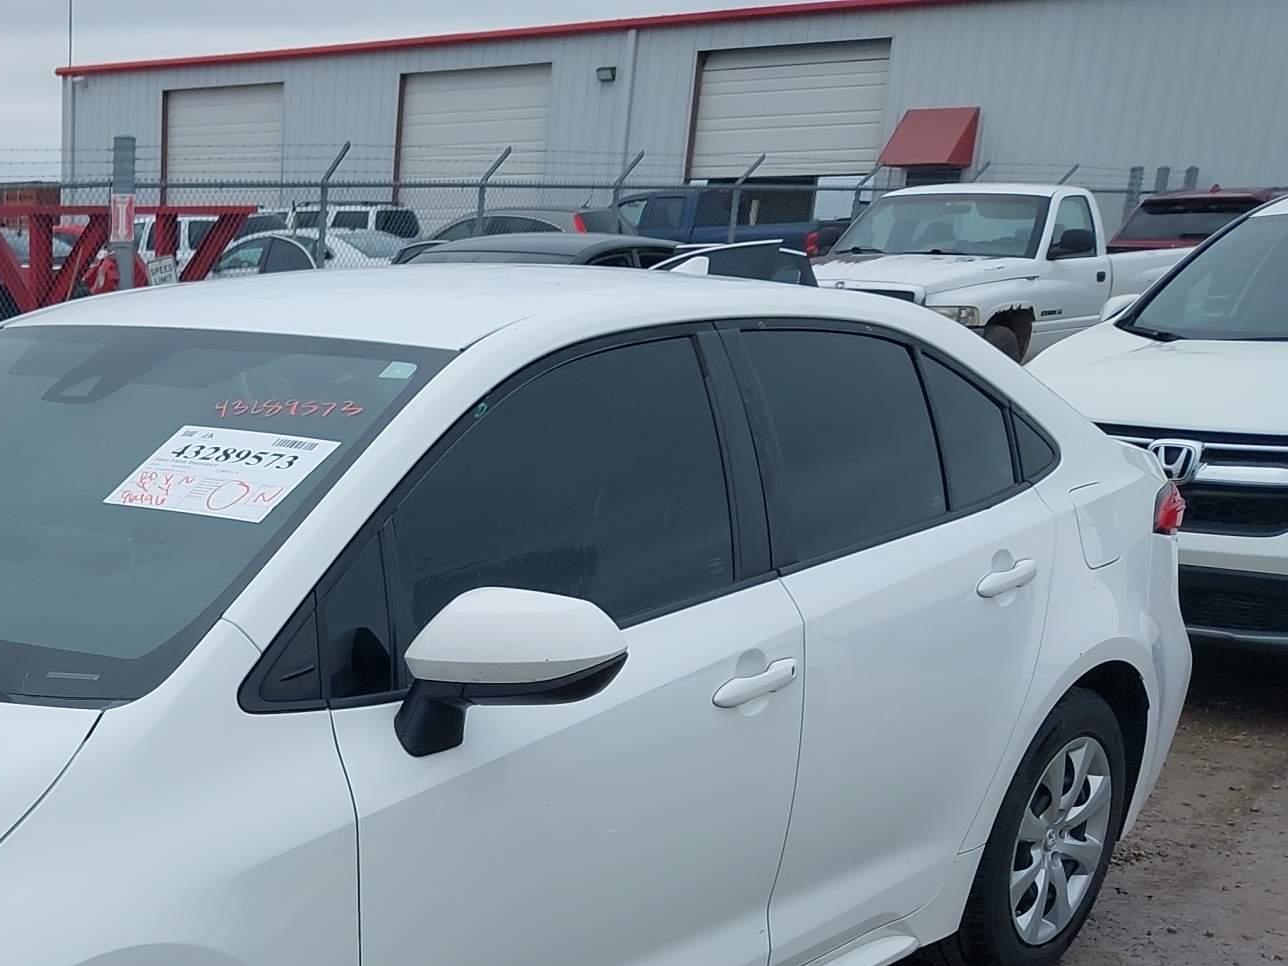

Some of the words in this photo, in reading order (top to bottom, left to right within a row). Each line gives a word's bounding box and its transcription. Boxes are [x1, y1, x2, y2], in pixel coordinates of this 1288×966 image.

[150, 263, 174, 277] SPEED
[153, 273, 174, 285] LIMIT
[171, 442, 300, 470] 43289573
